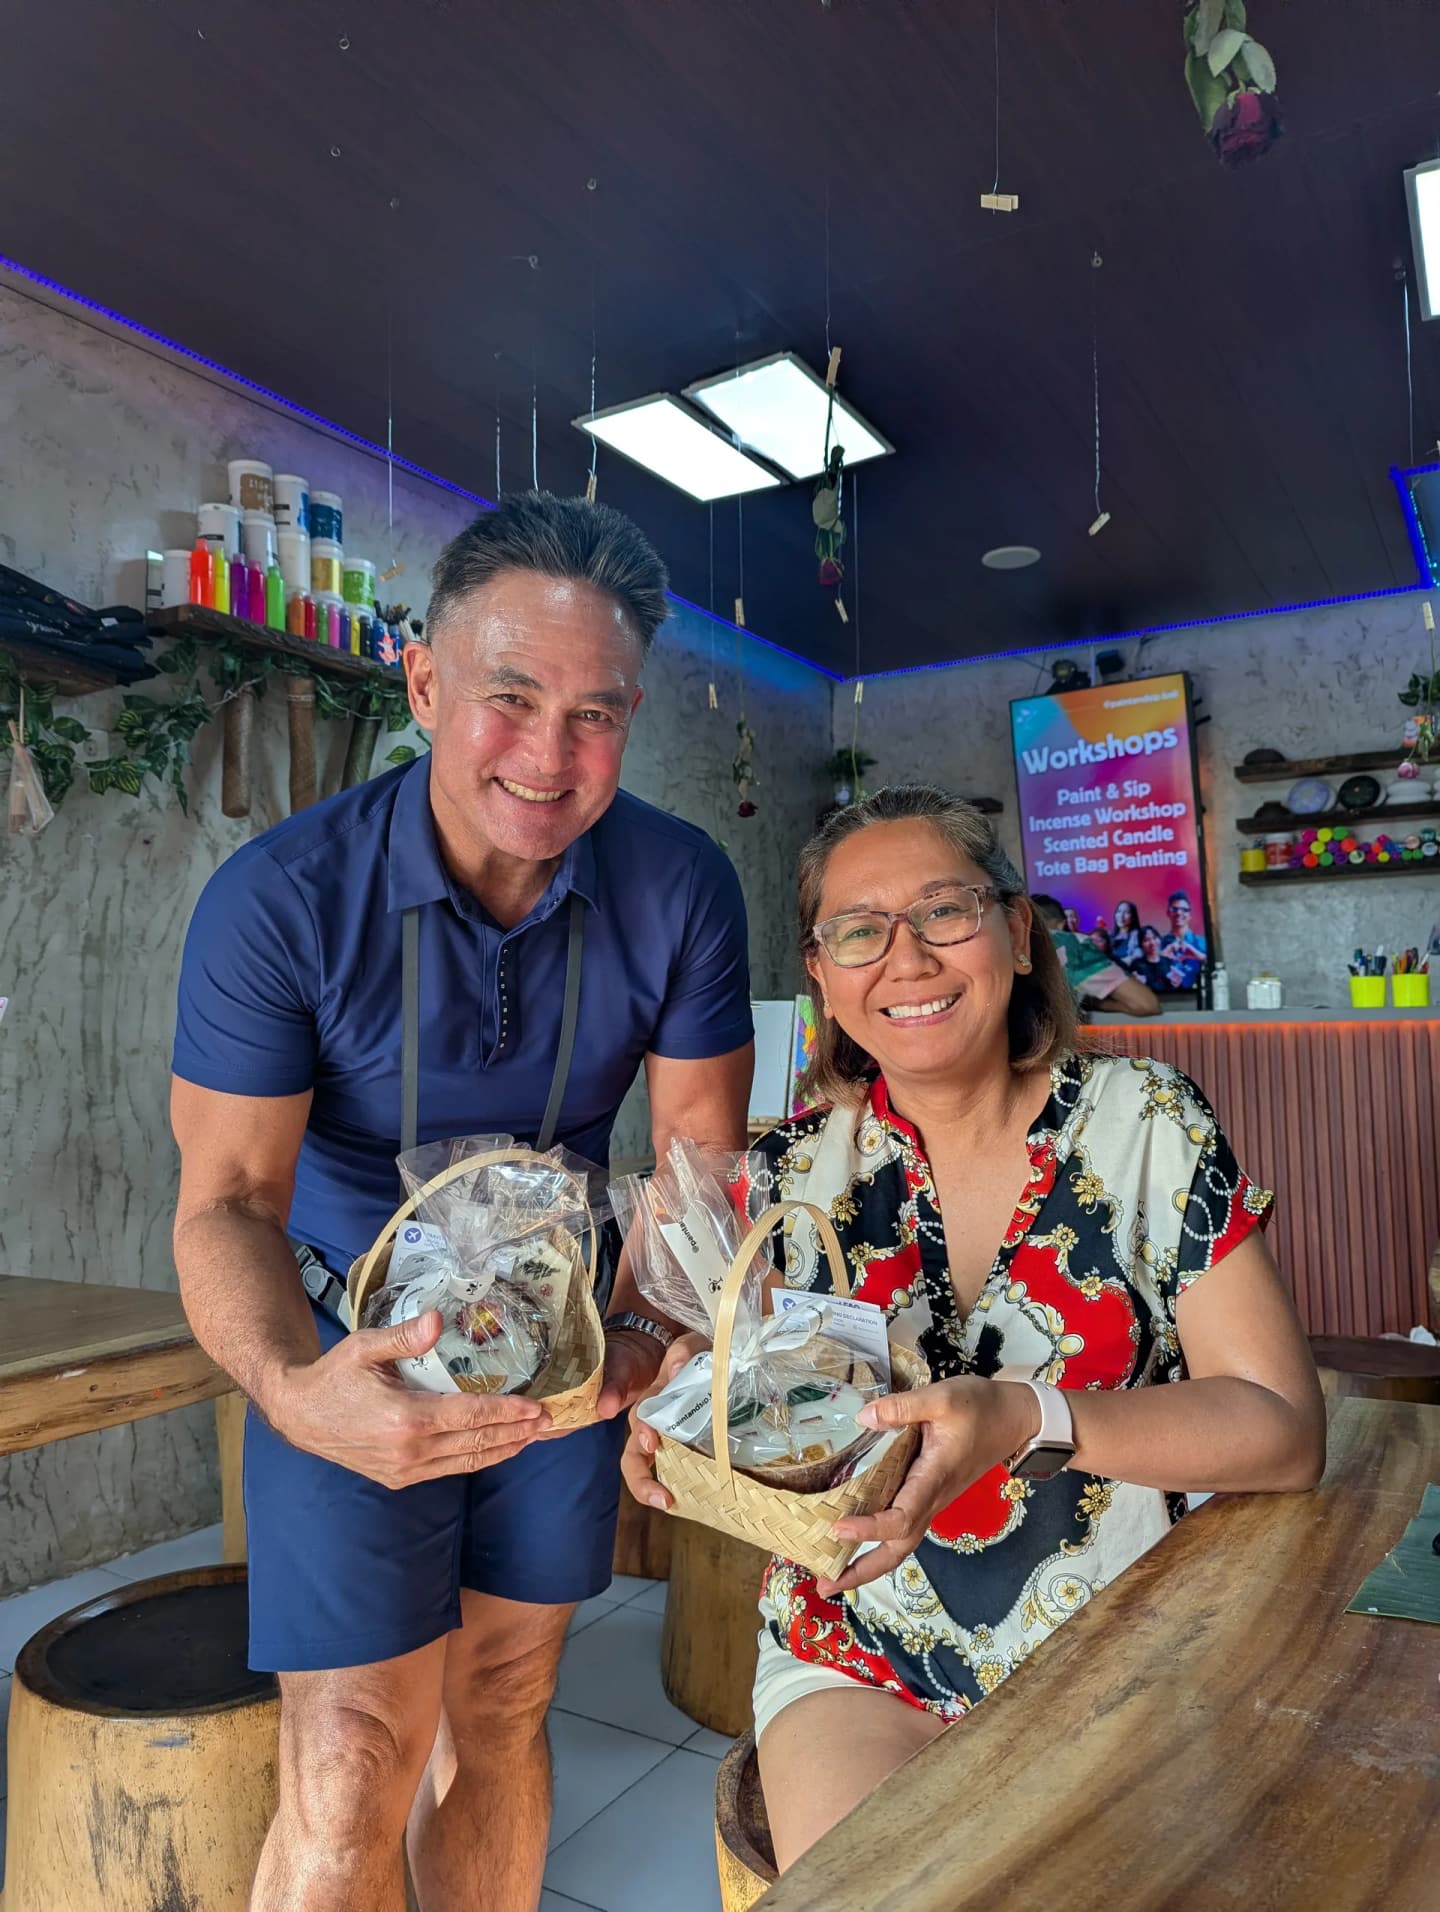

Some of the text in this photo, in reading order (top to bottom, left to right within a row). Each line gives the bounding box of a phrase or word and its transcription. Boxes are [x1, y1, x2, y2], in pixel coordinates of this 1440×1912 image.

[1022, 727, 1178, 775] Workshops
[1057, 780, 1152, 805] Paint & Sip
[1029, 802, 1186, 832] Incense Workshop
[1043, 825, 1174, 853] Scented Candle
[1035, 849, 1188, 877] Tote Bag Painting
